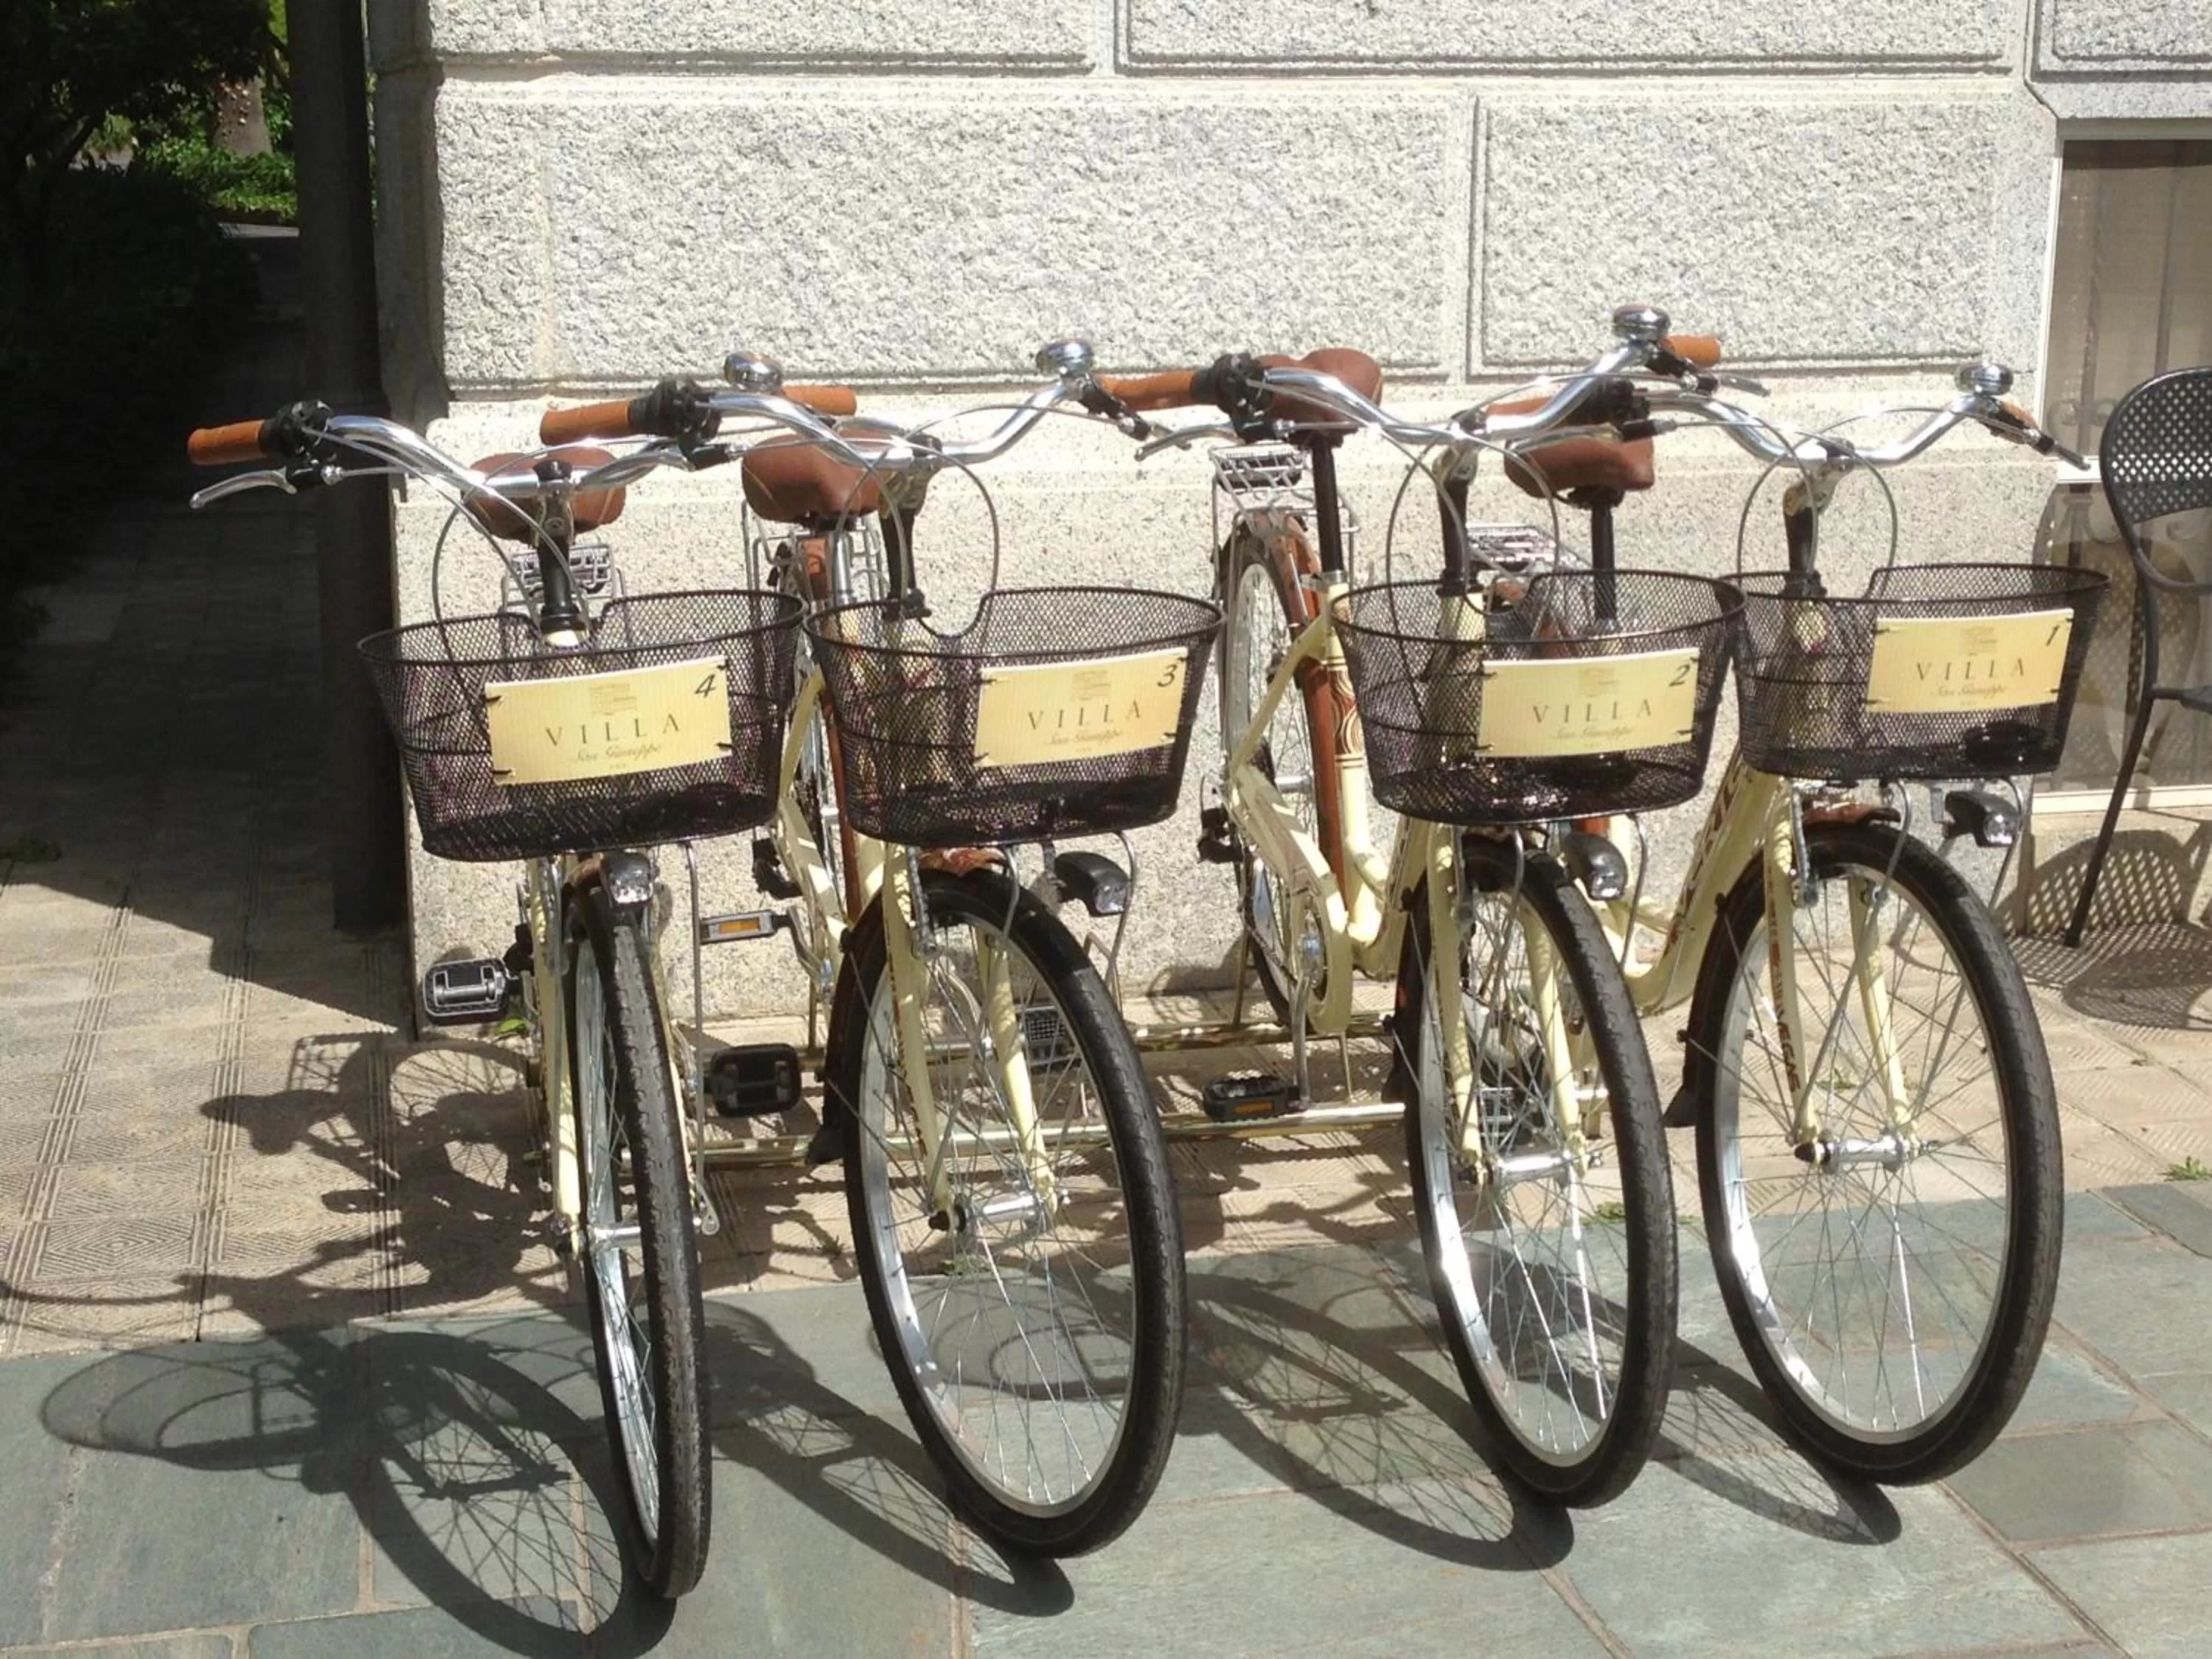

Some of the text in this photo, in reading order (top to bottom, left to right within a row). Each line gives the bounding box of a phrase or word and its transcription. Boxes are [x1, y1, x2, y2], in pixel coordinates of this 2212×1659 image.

[2046, 624, 2061, 647] 1
[1157, 663, 1178, 688] 3
[1669, 663, 1691, 687] 2
[1916, 657, 2025, 681] VILLA
[694, 672, 716, 698] 4
[1028, 699, 1141, 730] VILLA
[1532, 698, 1652, 723] VILLA
[545, 712, 680, 746] VILLA
